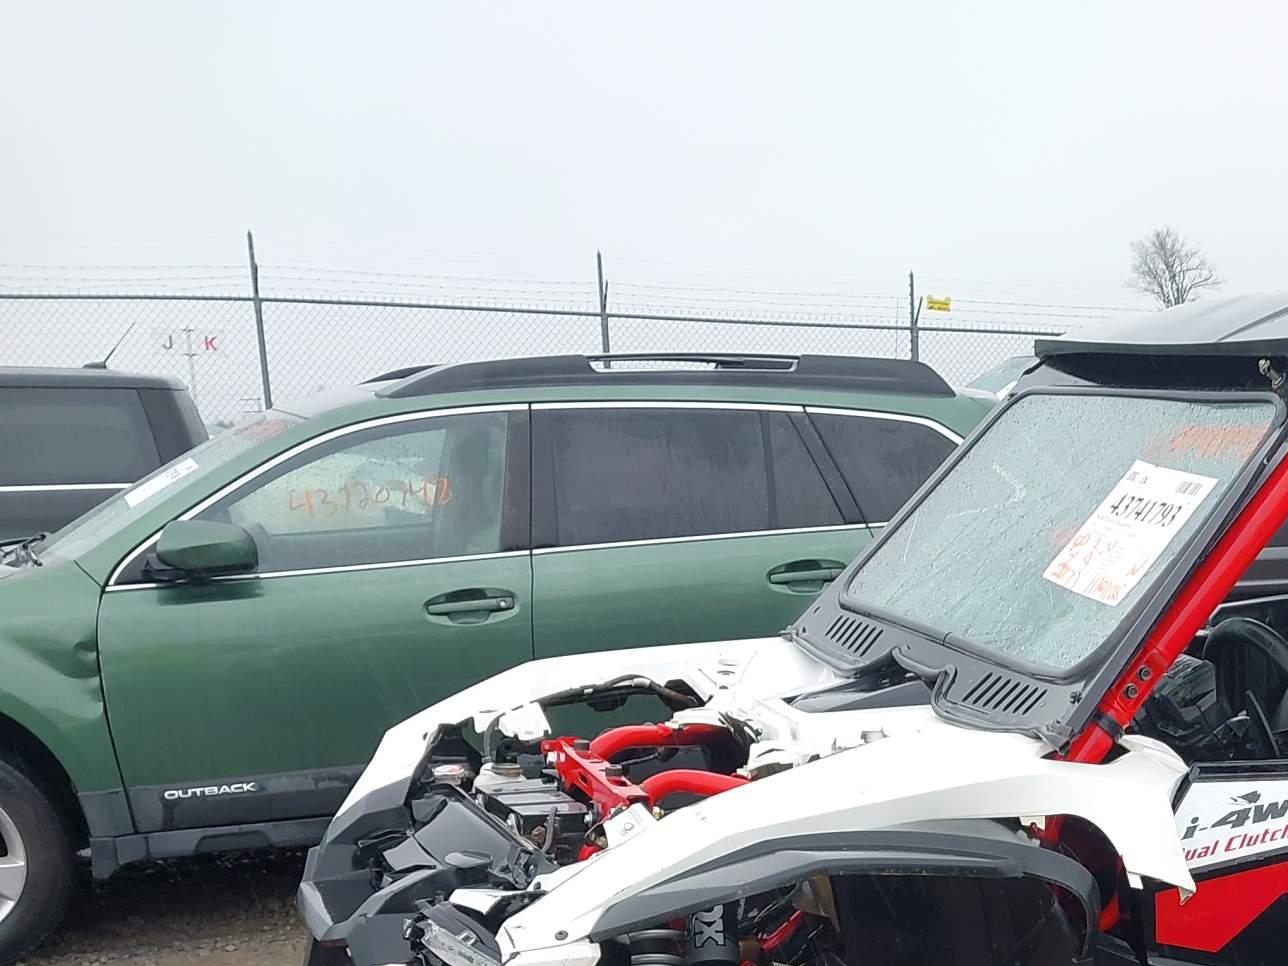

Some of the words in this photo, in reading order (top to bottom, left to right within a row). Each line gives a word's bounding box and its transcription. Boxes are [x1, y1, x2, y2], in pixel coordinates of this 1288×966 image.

[162, 335, 173, 350] J
[204, 335, 218, 351] K
[1110, 493, 1183, 528] 43741793
[164, 782, 256, 800] OUTBACK
[1183, 840, 1219, 862] ual
